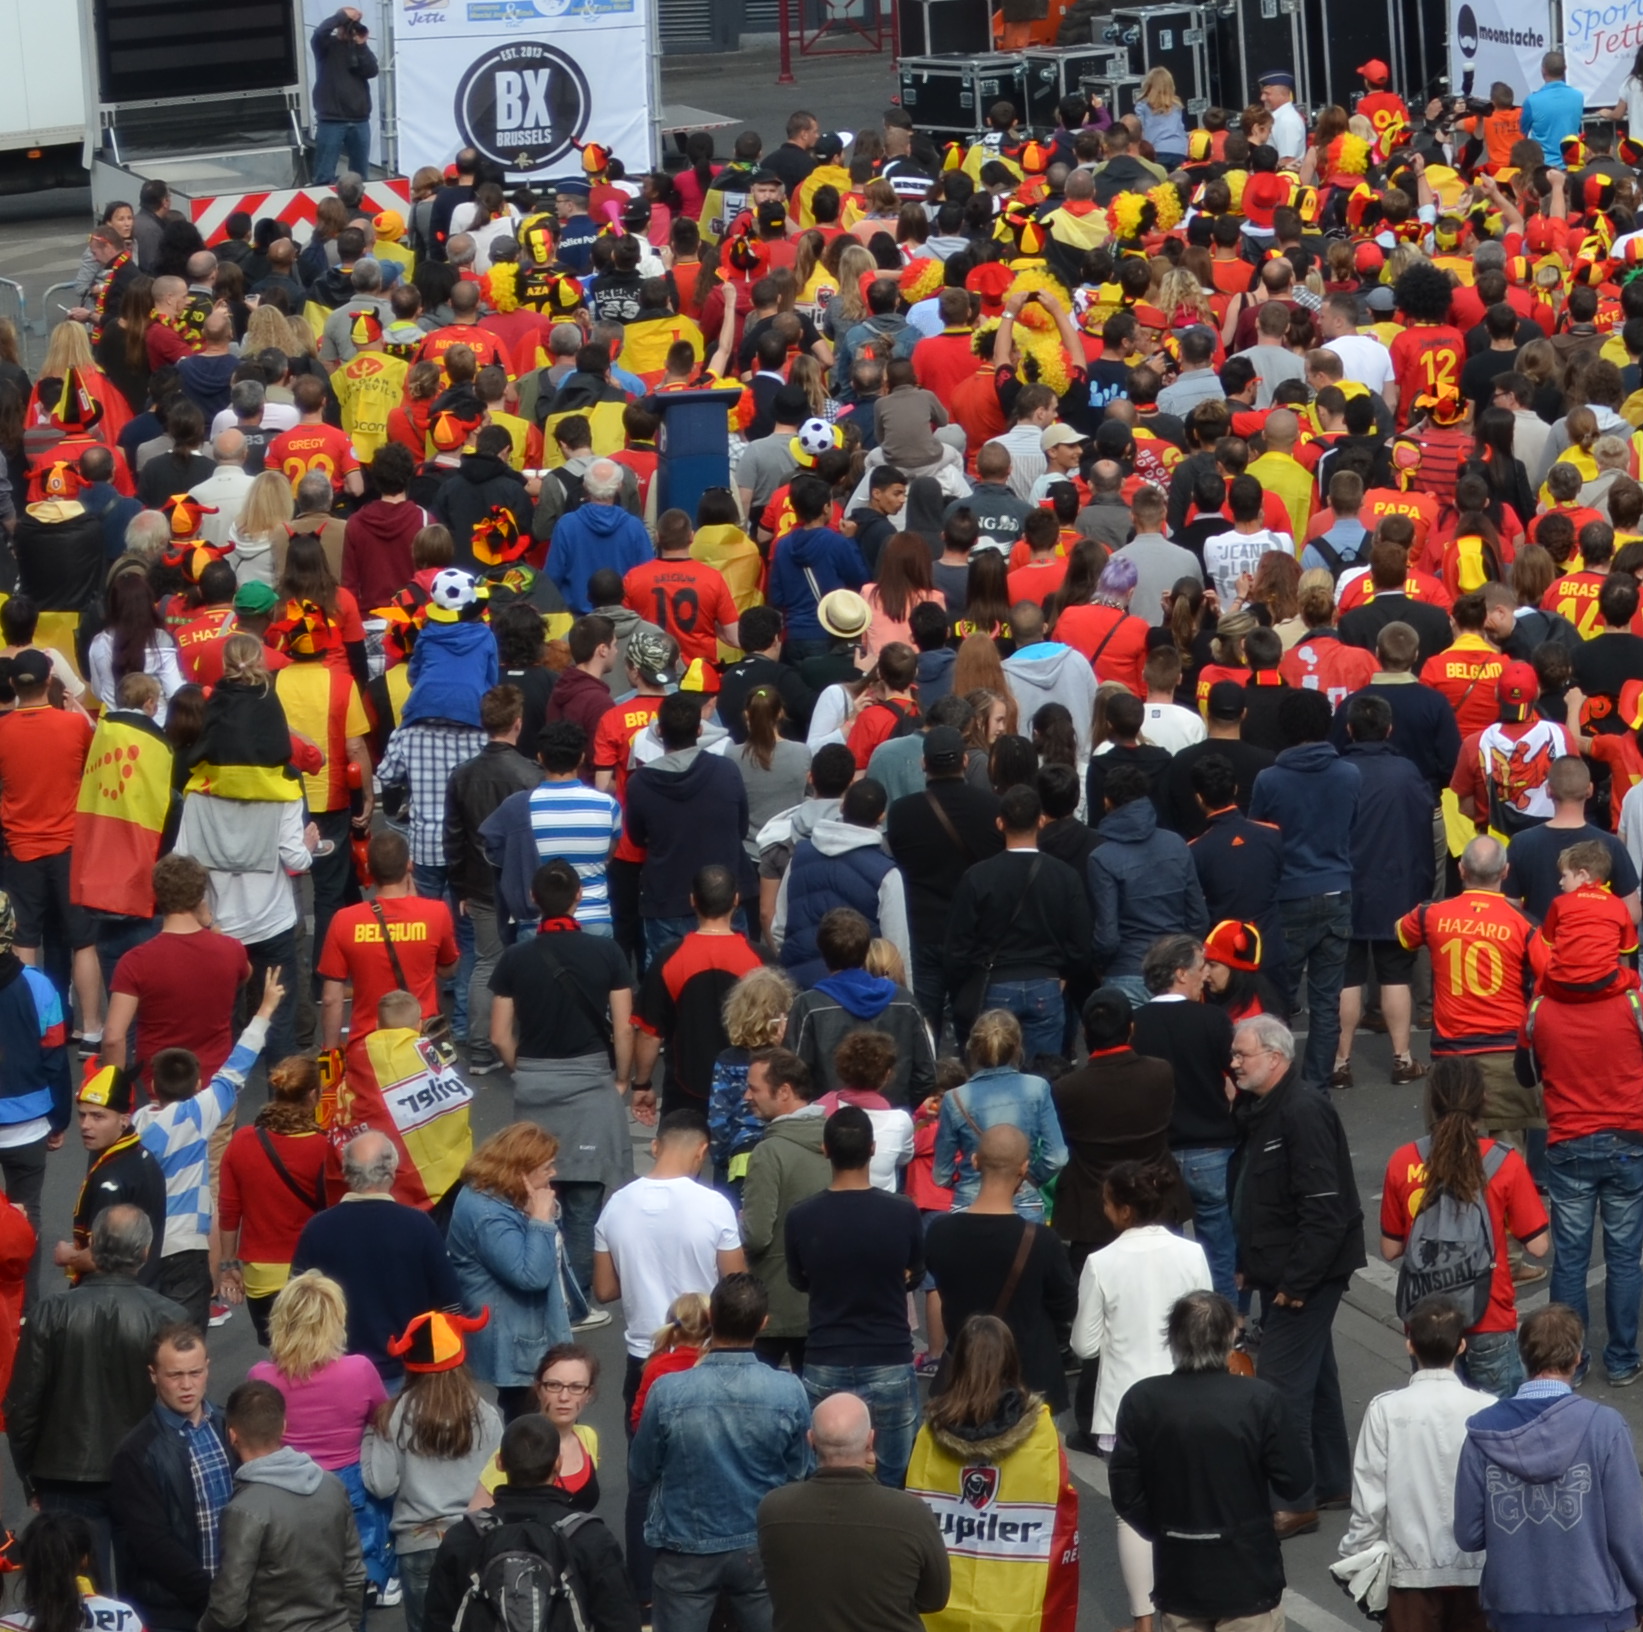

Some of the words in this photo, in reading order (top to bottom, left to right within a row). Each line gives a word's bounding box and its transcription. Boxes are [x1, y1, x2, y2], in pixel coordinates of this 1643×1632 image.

[408, 12, 447, 27] Jette
[1479, 25, 1544, 48] moonstache
[495, 69, 551, 131] BX
[496, 128, 552, 147] BRUSSELS
[1420, 349, 1457, 386] 12
[288, 437, 326, 449] GREGY
[1372, 502, 1420, 518] PAPA
[1559, 581, 1599, 598] BRAS
[651, 587, 700, 635] 10
[1445, 661, 1503, 681] BELGIUM
[354, 921, 428, 943] BELGIUM
[1436, 916, 1512, 942] HAZARD
[1440, 937, 1504, 997] 10
